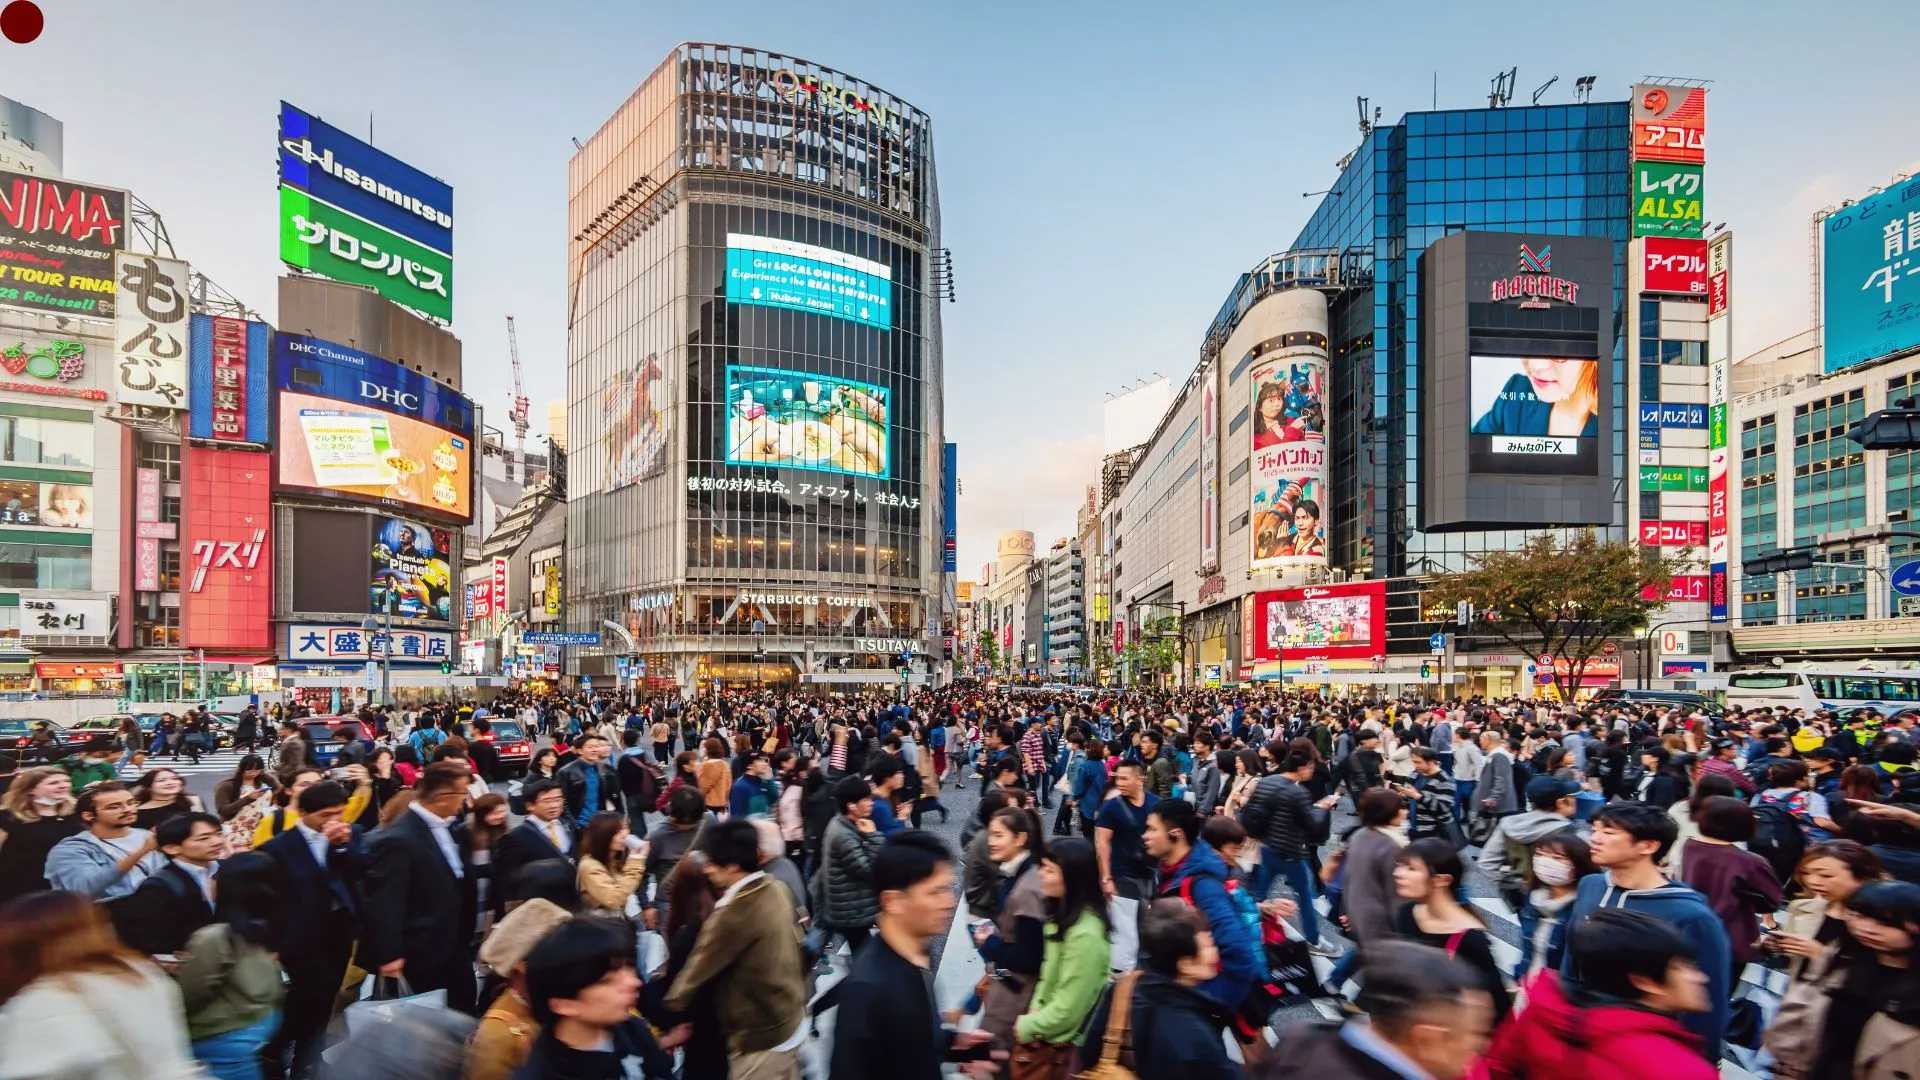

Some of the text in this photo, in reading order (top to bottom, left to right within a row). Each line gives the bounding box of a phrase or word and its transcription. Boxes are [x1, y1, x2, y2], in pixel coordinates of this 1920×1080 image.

[1645, 125, 1704, 149] アコム
[282, 138, 451, 229] Hisamitsu
[1640, 171, 1700, 196] レイク
[1638, 197, 1700, 220] ALSA
[292, 214, 446, 297] サロンパス
[1647, 254, 1705, 273] アイフル
[11, 266, 65, 287] TOUR
[731, 268, 787, 284] Experience
[789, 276, 805, 287] the
[807, 278, 836, 294] REAL
[753, 258, 771, 269] Get
[774, 261, 812, 278] LOCAL
[813, 268, 857, 286] GUIDES
[1492, 275, 1579, 304] MAGNET
[1690, 281, 1705, 292] 8F
[23, 290, 96, 310] Release!!
[806, 295, 834, 311] Japan
[1714, 282, 1724, 313] アイフル
[120, 256, 184, 404] もんじゃ
[289, 341, 364, 365] DHC Channel
[360, 380, 418, 411] DHC
[1641, 409, 1703, 424] レオパレス21
[1507, 440, 1562, 453] みんなのFX
[687, 476, 791, 494] 後初の対外試合。
[1640, 472, 1660, 481] レイク
[1661, 472, 1683, 481] ALSA
[382, 498, 399, 506] DHC
[1713, 490, 1725, 518] アコム
[1645, 526, 1687, 540] アコム
[190, 529, 266, 592] クスリ
[390, 558, 435, 576] Planets
[396, 552, 425, 564] teamLab
[741, 593, 870, 607] STARBUCKS COFFEE
[1713, 572, 1725, 607] PROMISE
[299, 631, 447, 657] 大盛堂書店
[857, 639, 919, 652] TSUTAYA
[1664, 632, 1684, 651] 0円
[1665, 665, 1691, 673] PROMISE
